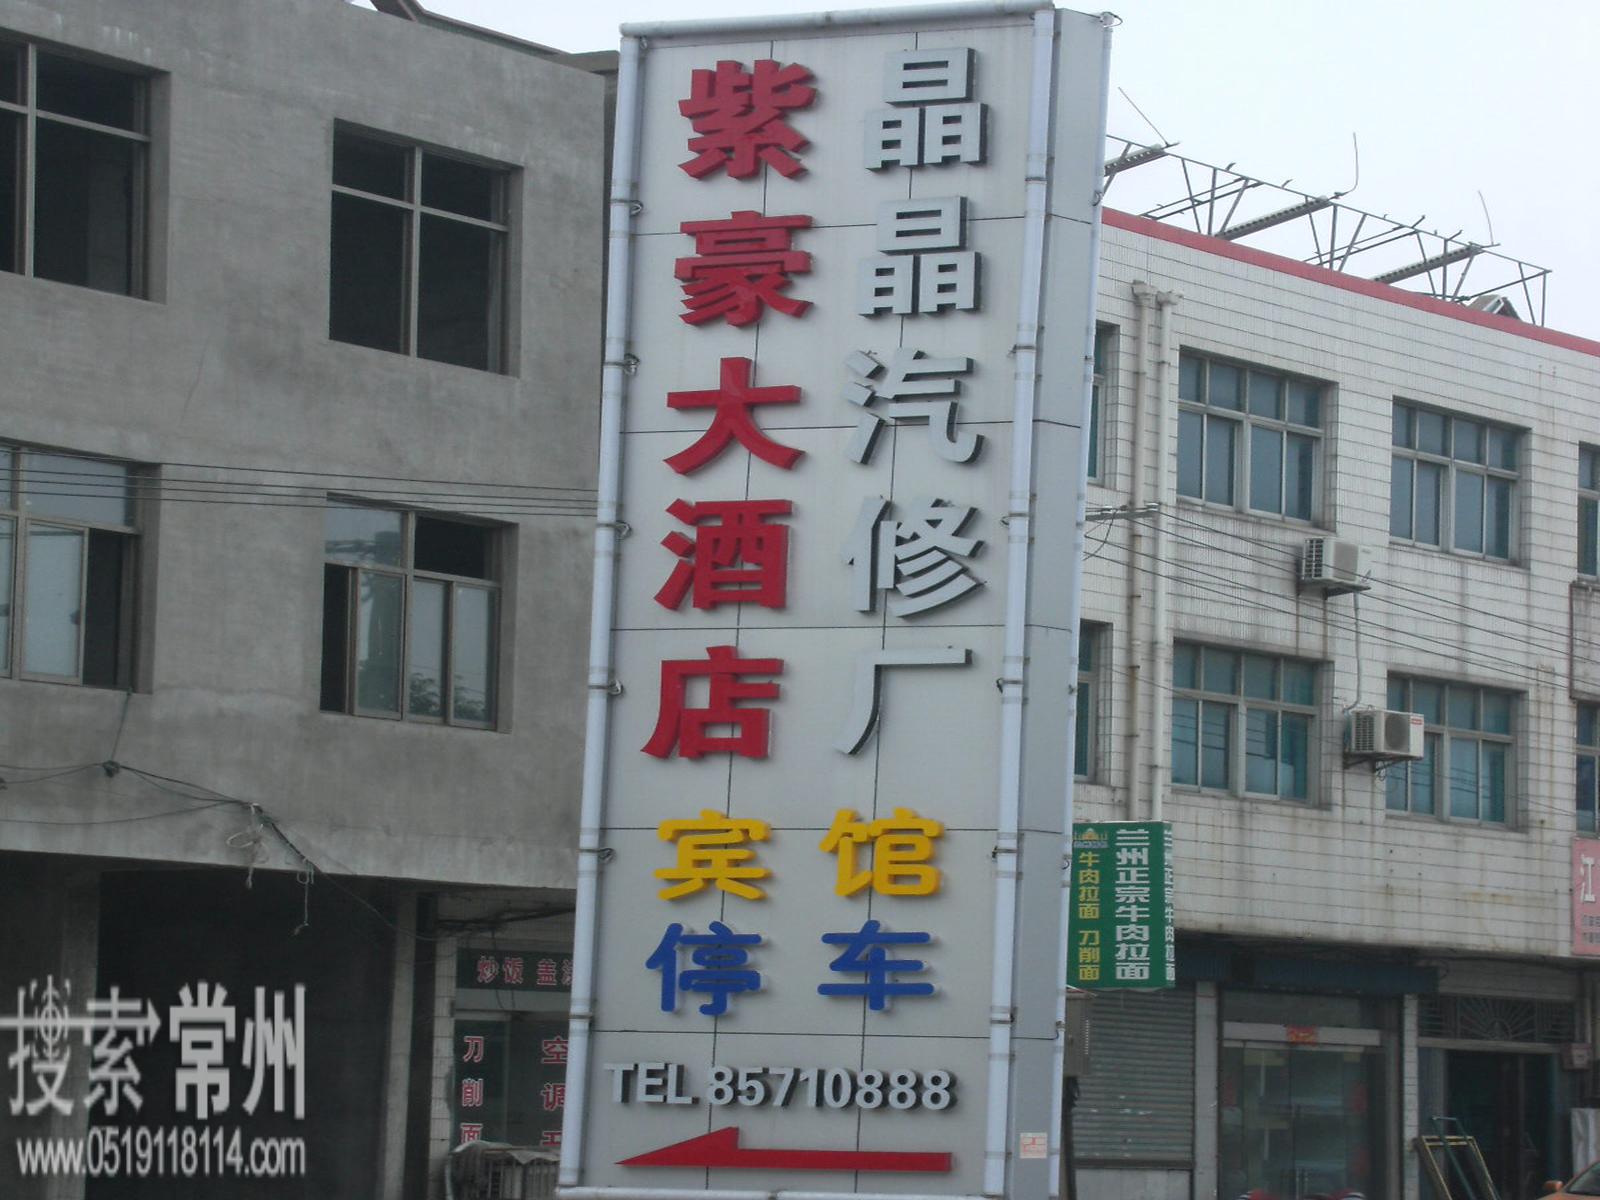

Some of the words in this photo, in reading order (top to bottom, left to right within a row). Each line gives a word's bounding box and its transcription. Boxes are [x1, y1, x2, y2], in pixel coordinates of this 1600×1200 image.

[640, 59, 818, 760] 紫豪大酒店
[834, 48, 988, 755] 晶晶汽修厂
[653, 808, 945, 902] 宾馆
[1078, 851, 1101, 920] 牛肉拉面
[1115, 829, 1151, 981] 兰州正宗牛肉拉面
[477, 955, 524, 985] 炒饭
[645, 919, 938, 1016] 停车
[1078, 929, 1101, 982] 刀削面
[460, 1035, 485, 1143] 刀削面
[707, 1064, 956, 1111] 85710888
